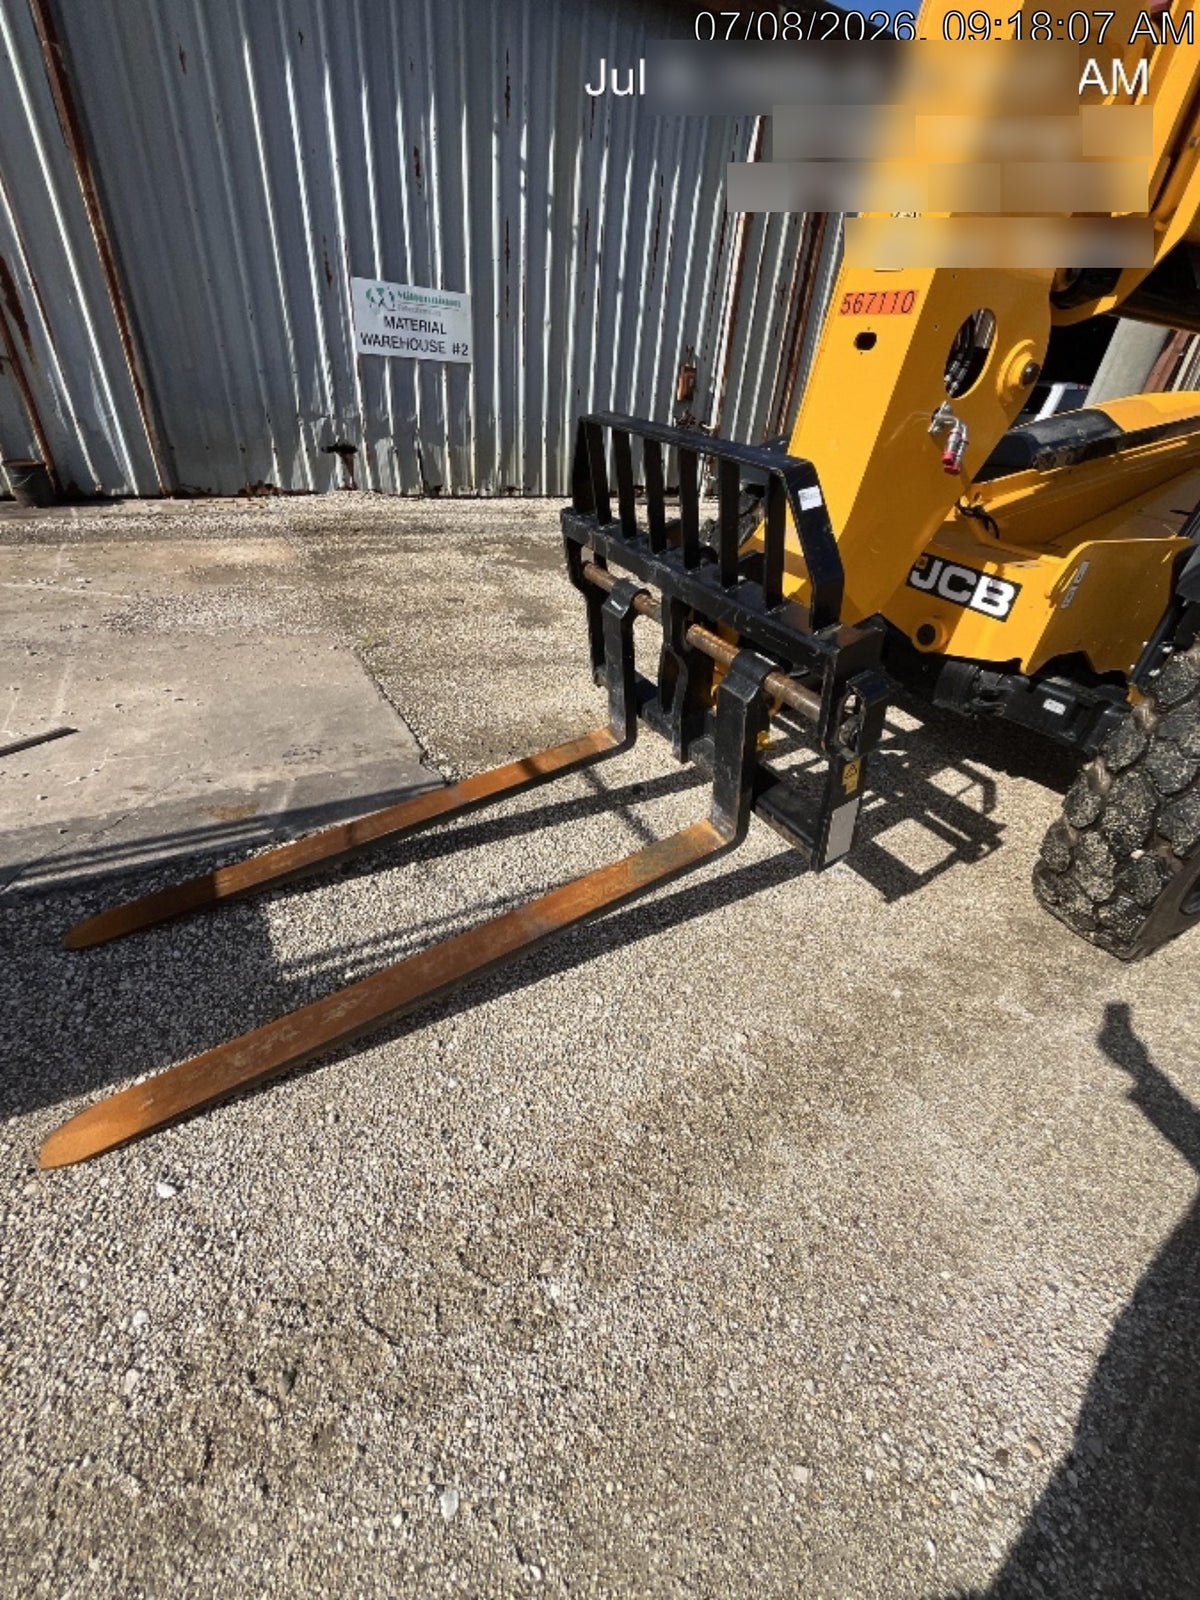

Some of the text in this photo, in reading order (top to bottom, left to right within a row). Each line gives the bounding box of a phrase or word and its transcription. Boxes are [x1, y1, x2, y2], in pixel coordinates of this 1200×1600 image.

[840, 290, 915, 315] 567110
[383, 315, 447, 335] MATERIAL
[360, 332, 469, 356] WAREHOUSE #2
[909, 560, 1016, 618] JCB
